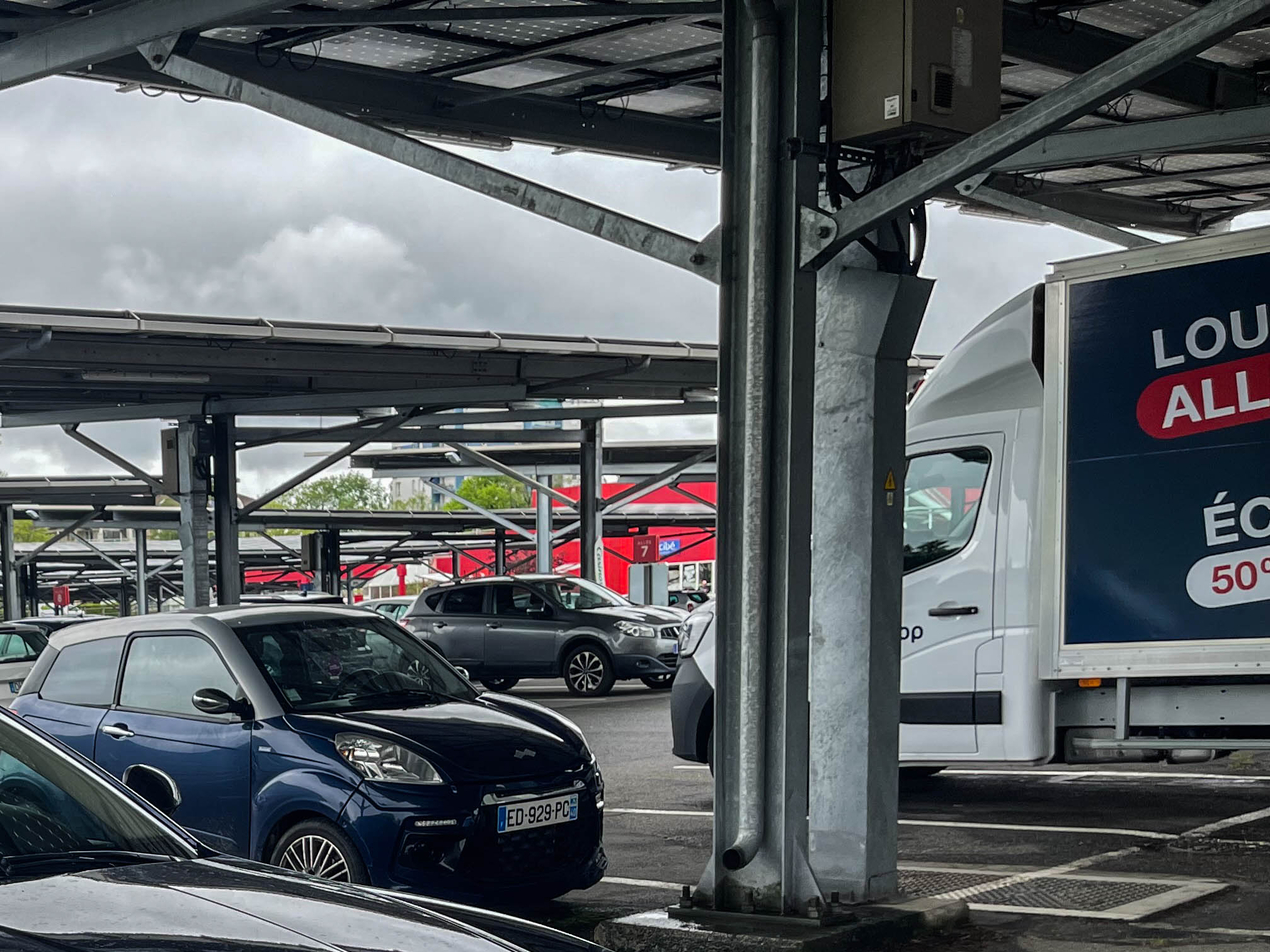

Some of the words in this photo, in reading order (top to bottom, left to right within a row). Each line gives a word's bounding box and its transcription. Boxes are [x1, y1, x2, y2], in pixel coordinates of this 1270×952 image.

[1152, 304, 1269, 369] LOU
[1162, 371, 1270, 429] ALL
[641, 545, 648, 558] 7
[507, 800, 569, 828] ED-929-PC
